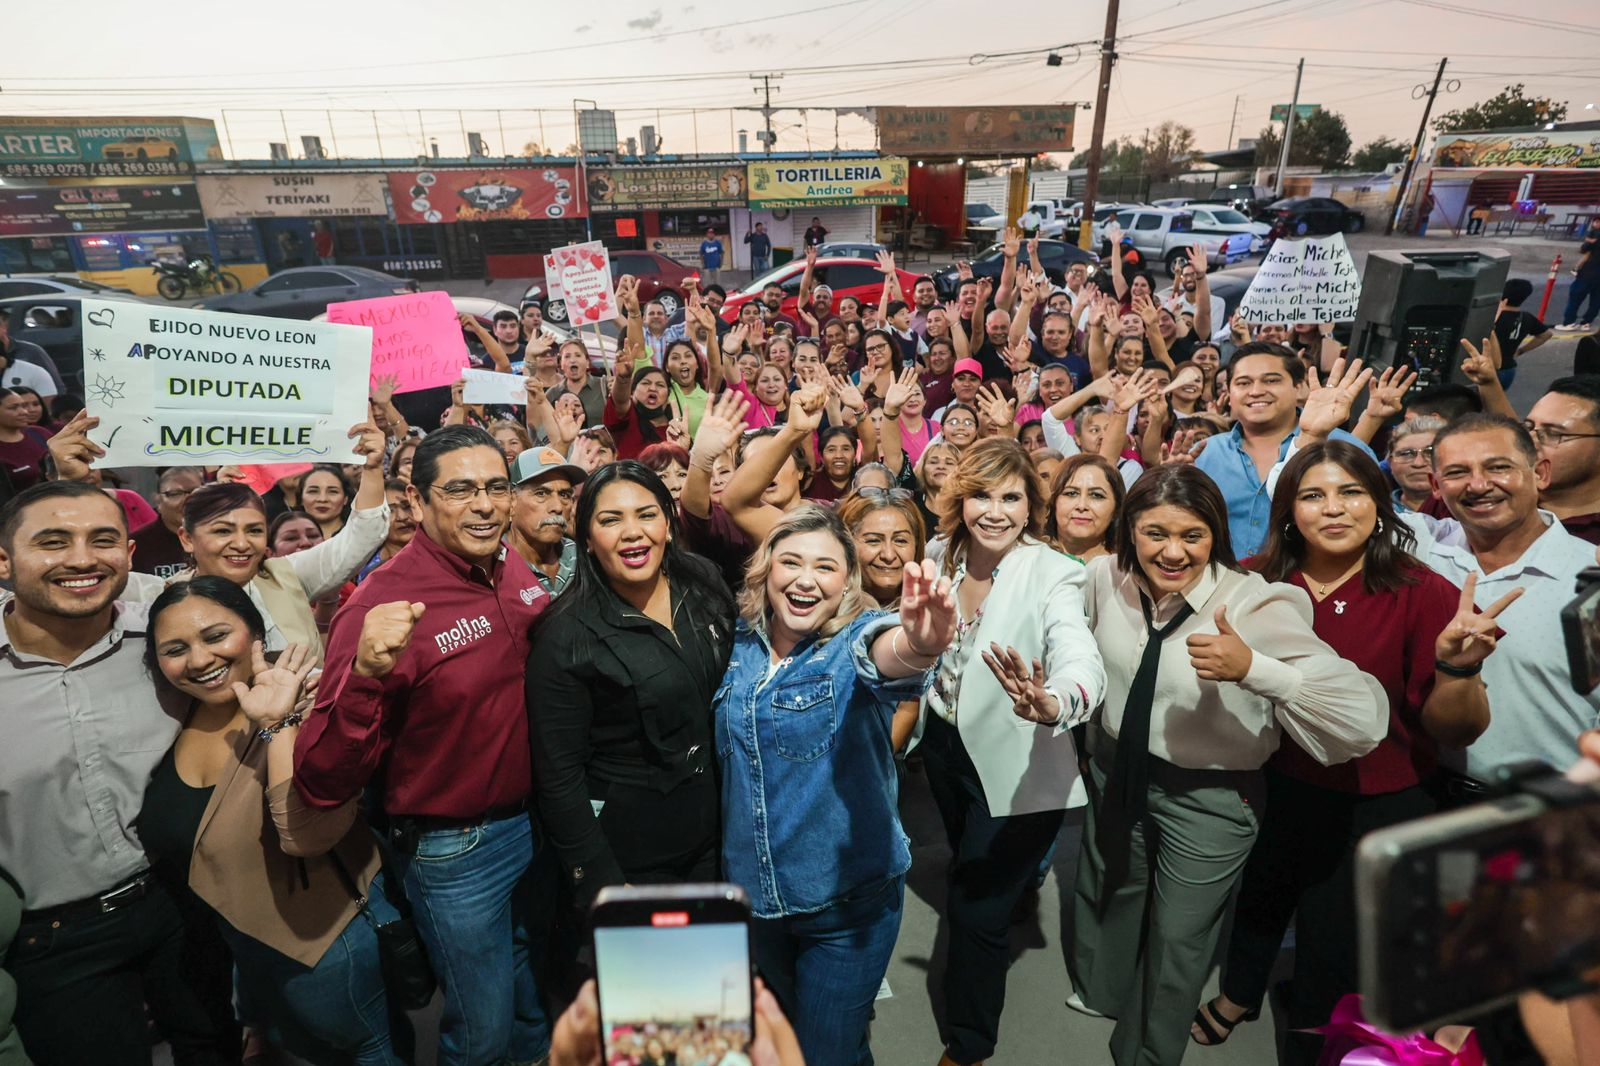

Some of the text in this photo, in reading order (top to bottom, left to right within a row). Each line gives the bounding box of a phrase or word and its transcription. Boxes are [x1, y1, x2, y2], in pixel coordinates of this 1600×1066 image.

[77, 128, 182, 137] IMPORTACIONES
[7, 164, 30, 174] 686
[32, 164, 54, 174] 269
[56, 164, 87, 174] 0779
[98, 163, 121, 173] 686
[123, 163, 145, 172] 269
[776, 167, 882, 182] TORTILLERIA
[273, 176, 315, 186] SUSHI
[624, 171, 711, 180] BIRRIERIA
[806, 185, 853, 196] Andrea
[265, 194, 330, 205] TERIYAKI
[1267, 252, 1298, 264] acias
[1293, 266, 1329, 278] Michelle
[573, 276, 597, 284] nuestra
[573, 284, 601, 293] diputada
[1249, 308, 1306, 322] Michelle
[149, 319, 316, 344] EJIDO NUEVO LEON
[127, 343, 331, 370] APOYANDO A NUESTRA
[169, 378, 302, 400] DIPUTADA
[435, 615, 491, 647] molina
[440, 626, 492, 654] DIPUTADO
